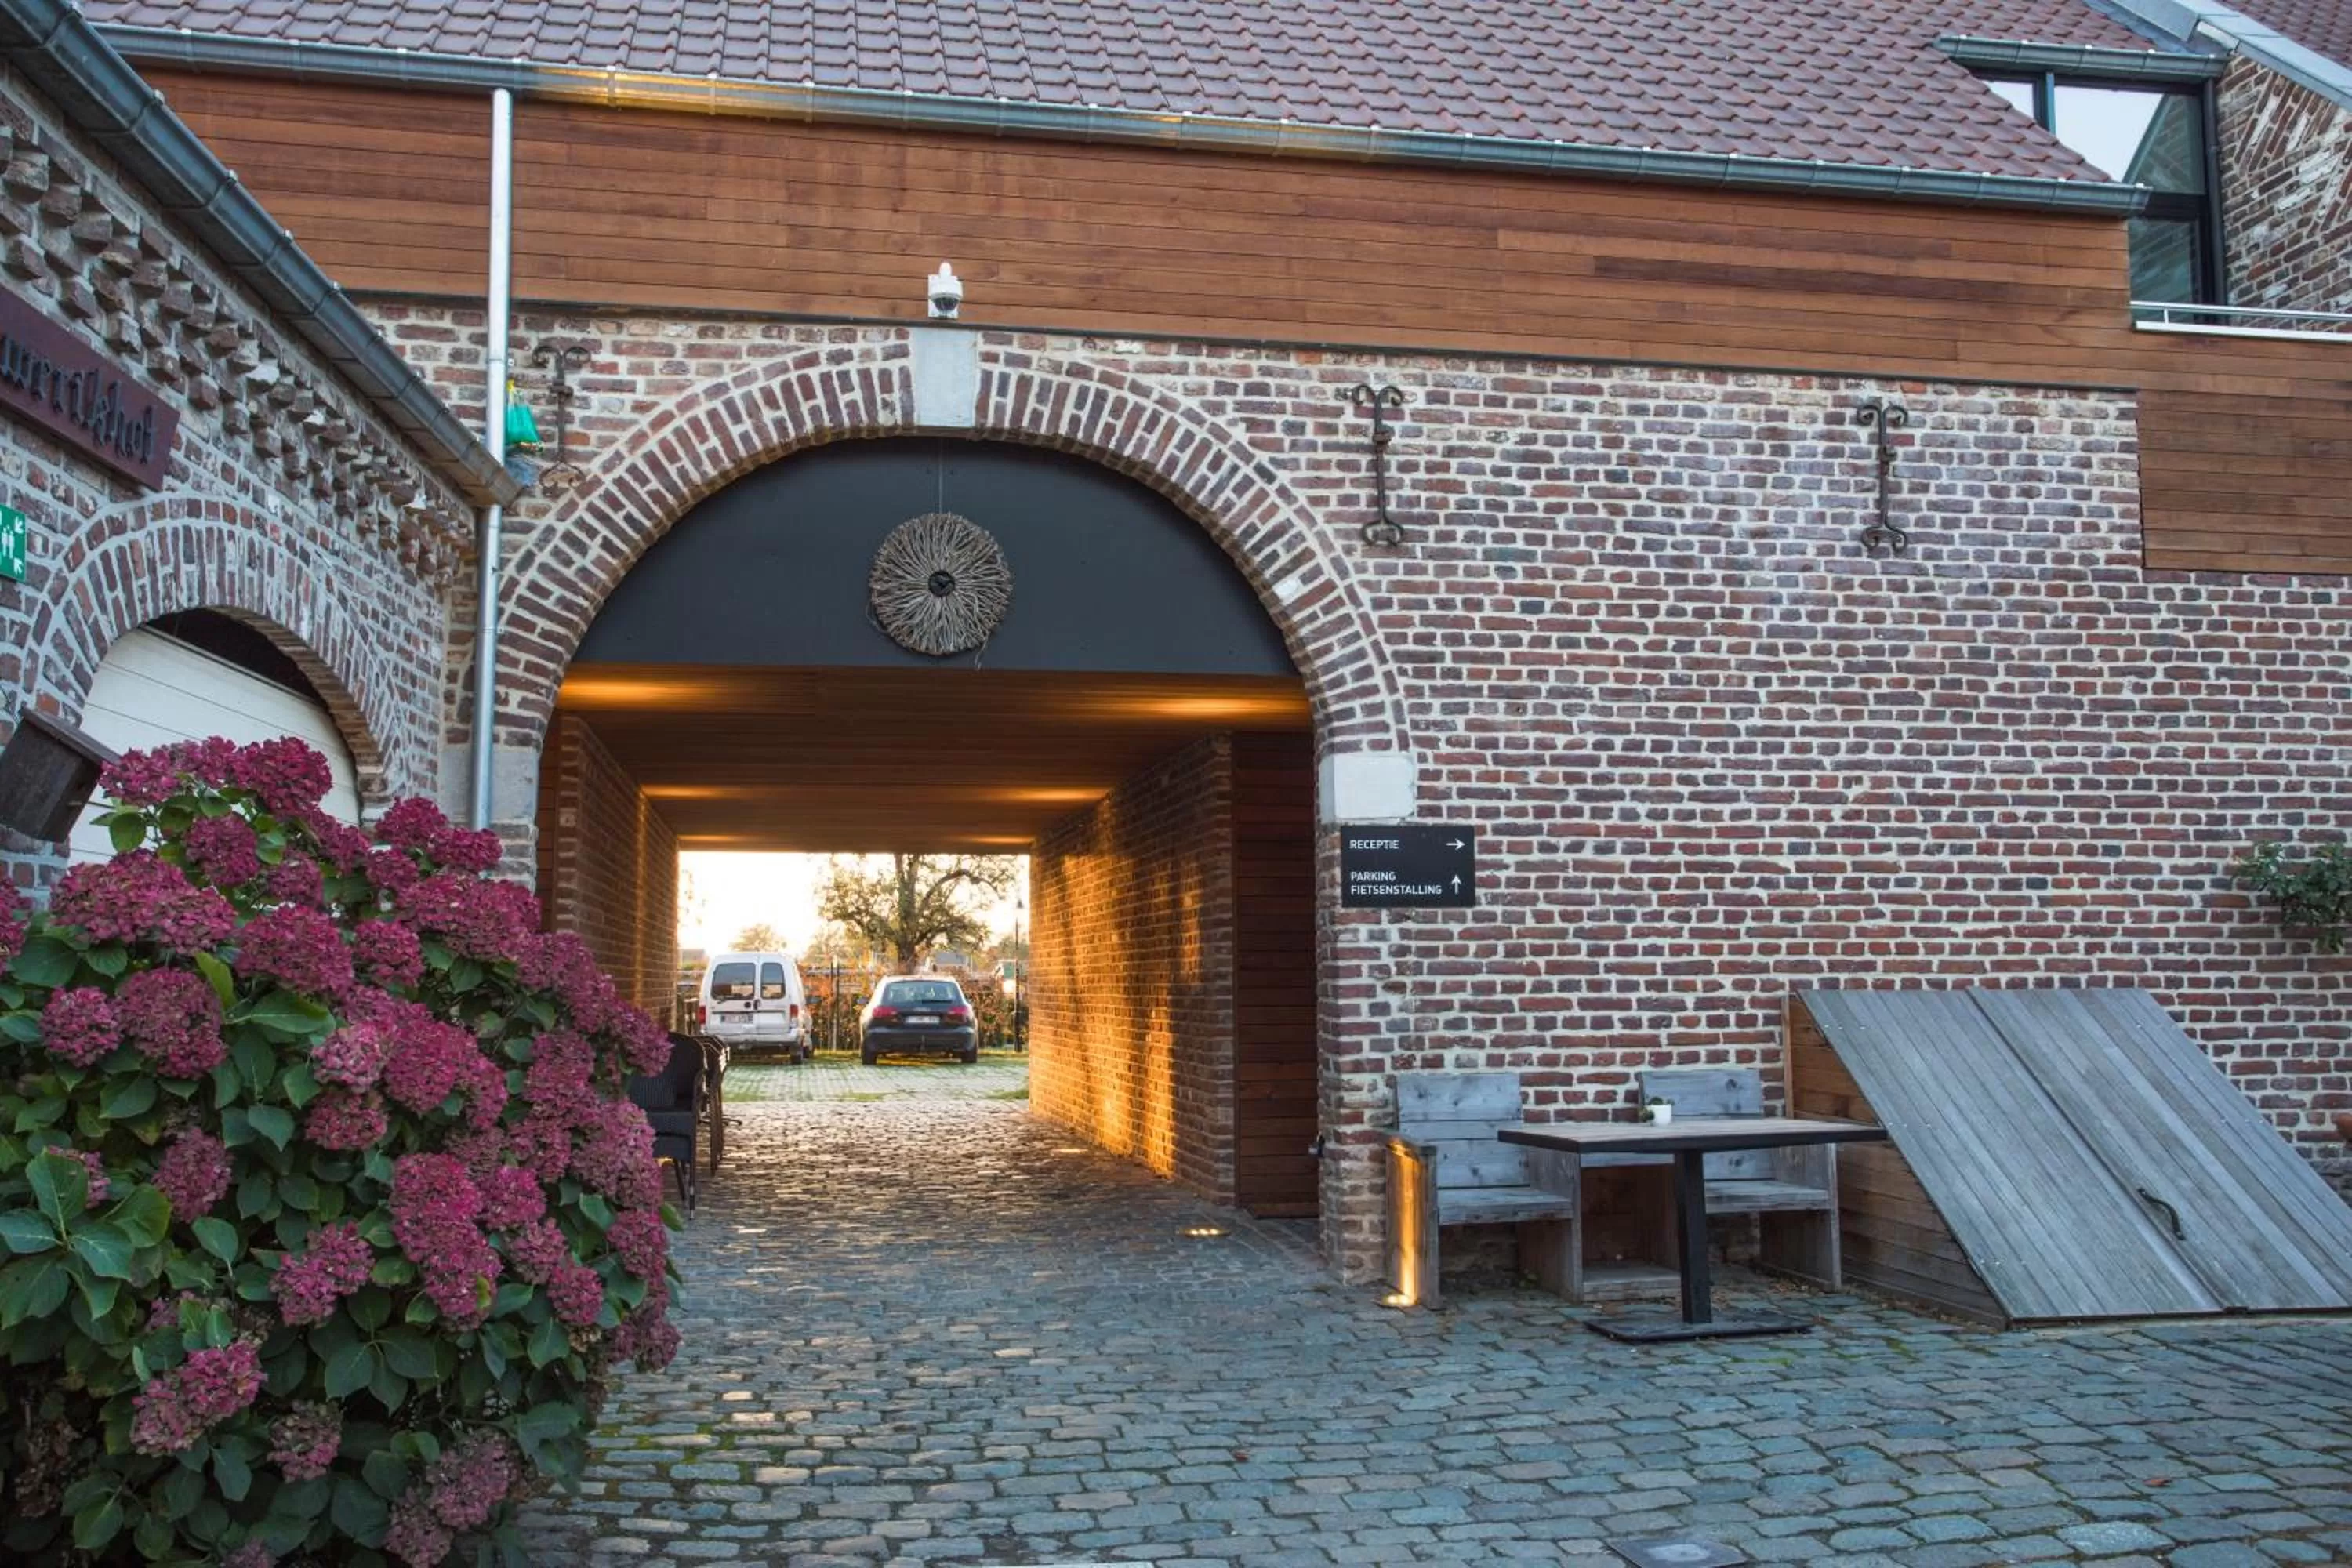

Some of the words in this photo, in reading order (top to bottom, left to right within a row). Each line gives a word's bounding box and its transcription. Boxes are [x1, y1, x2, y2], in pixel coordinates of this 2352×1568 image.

[1349, 840, 1399, 849] RECEPTIE
[1350, 872, 1396, 881] PARKING
[1351, 885, 1443, 895] FIETSENSTALLING
